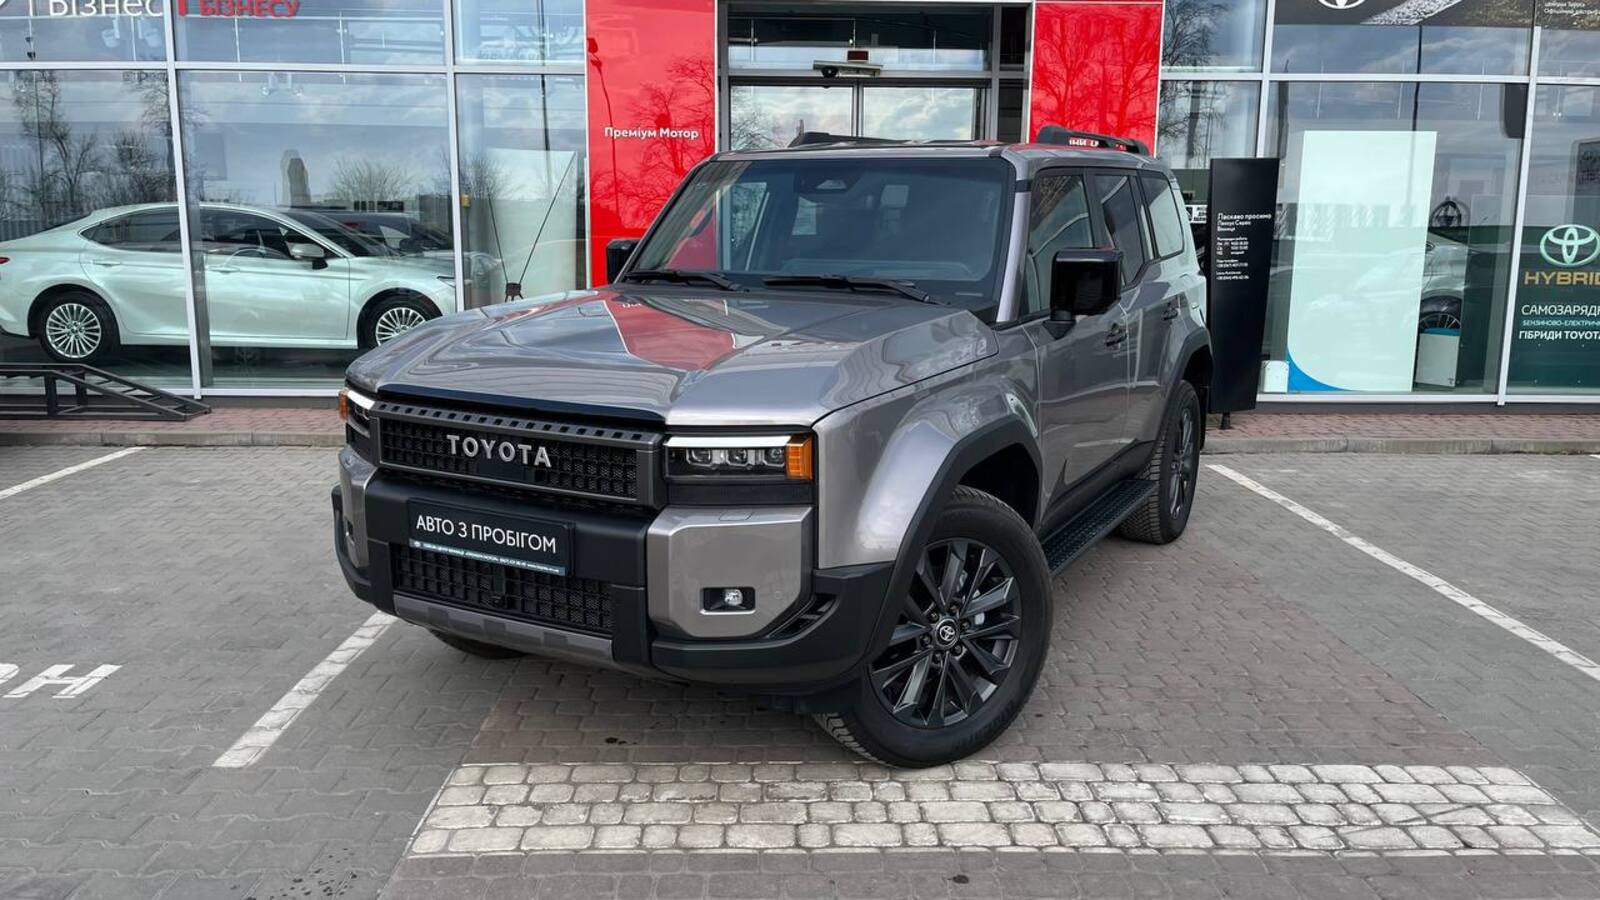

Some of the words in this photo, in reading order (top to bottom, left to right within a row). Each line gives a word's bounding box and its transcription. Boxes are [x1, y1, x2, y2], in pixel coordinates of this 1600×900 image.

[604, 127, 657, 140] Преміум
[660, 128, 699, 140] Мотор
[1518, 331, 1562, 341] ГІБРИДИ
[1563, 331, 1600, 340] TOYOT
[446, 434, 552, 468] TOYOTA
[416, 514, 455, 536] АВТО
[471, 523, 557, 554] ПРОБІГОМ
